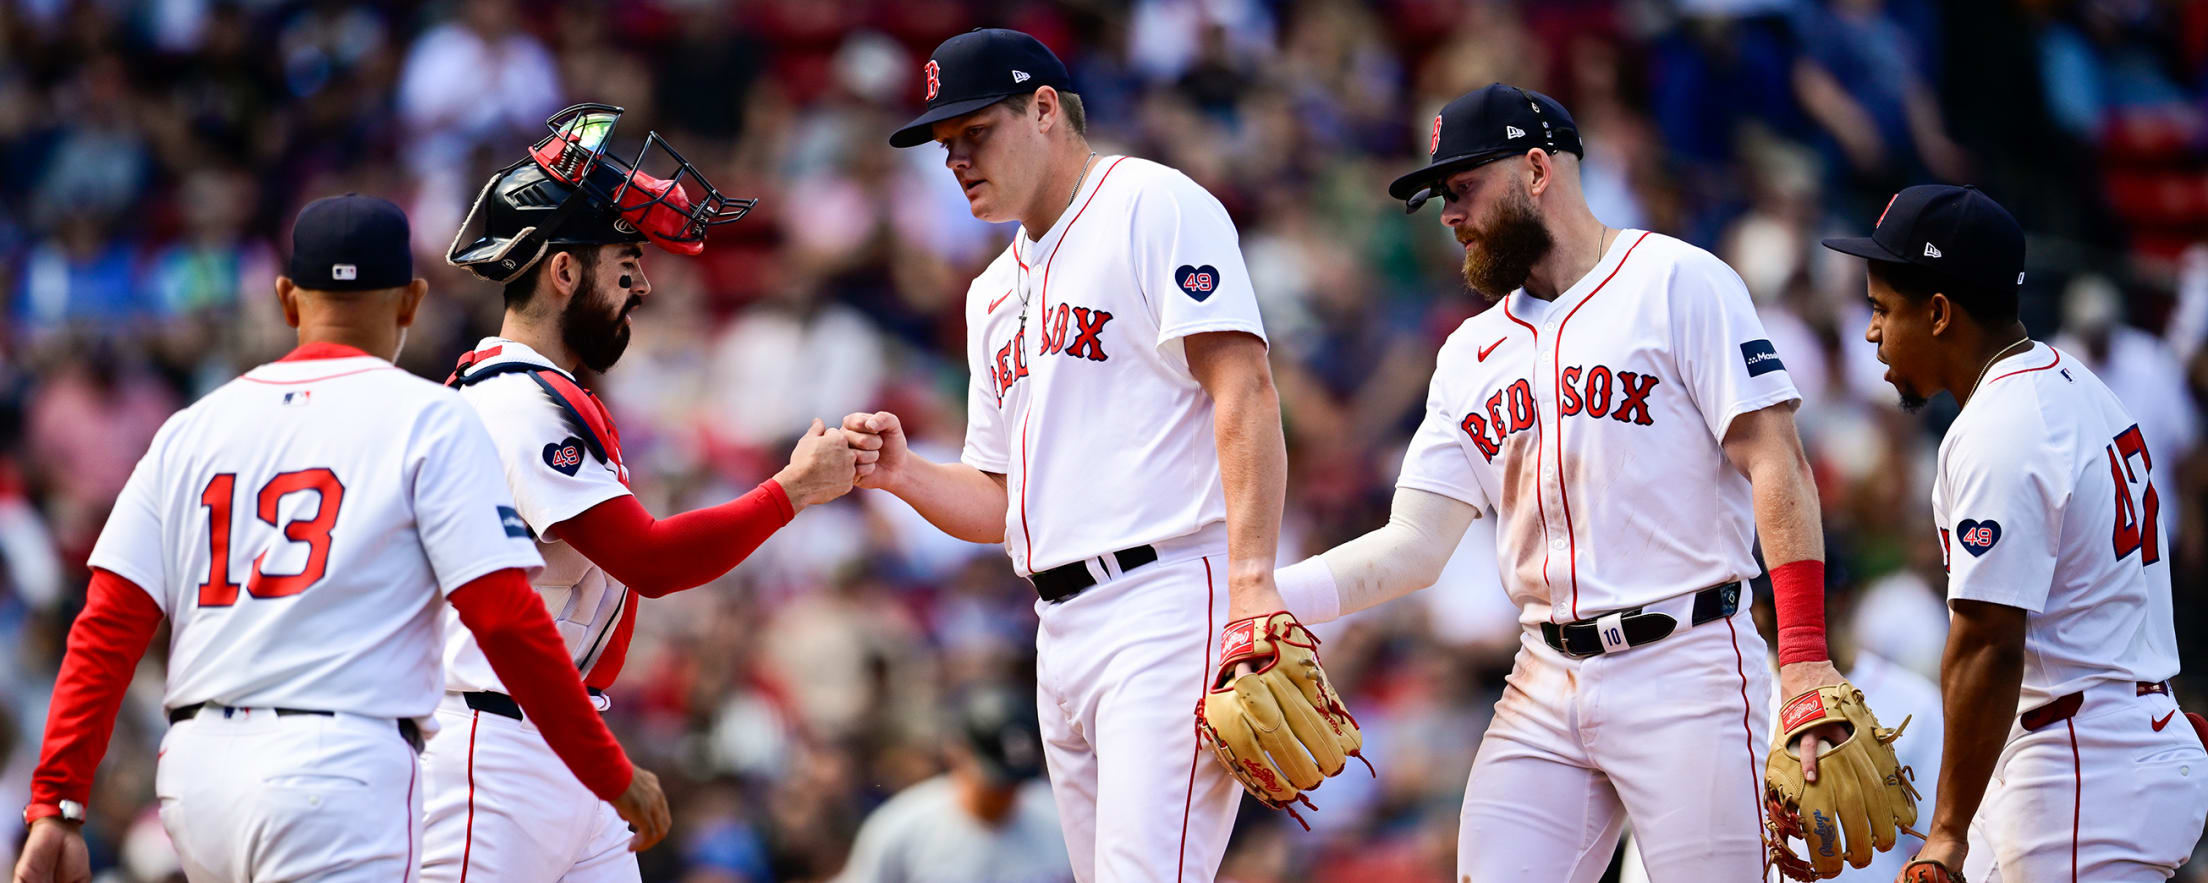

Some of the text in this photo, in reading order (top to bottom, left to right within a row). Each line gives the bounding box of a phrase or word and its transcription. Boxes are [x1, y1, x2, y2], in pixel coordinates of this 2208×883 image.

[924, 60, 940, 101] B
[1183, 272, 1212, 292] 49
[1461, 364, 1660, 464] RED SOX
[553, 445, 580, 468] 49
[2106, 422, 2160, 567] 47
[198, 467, 346, 608] 13
[1963, 527, 1993, 547] 49
[1603, 627, 1622, 647] 10
